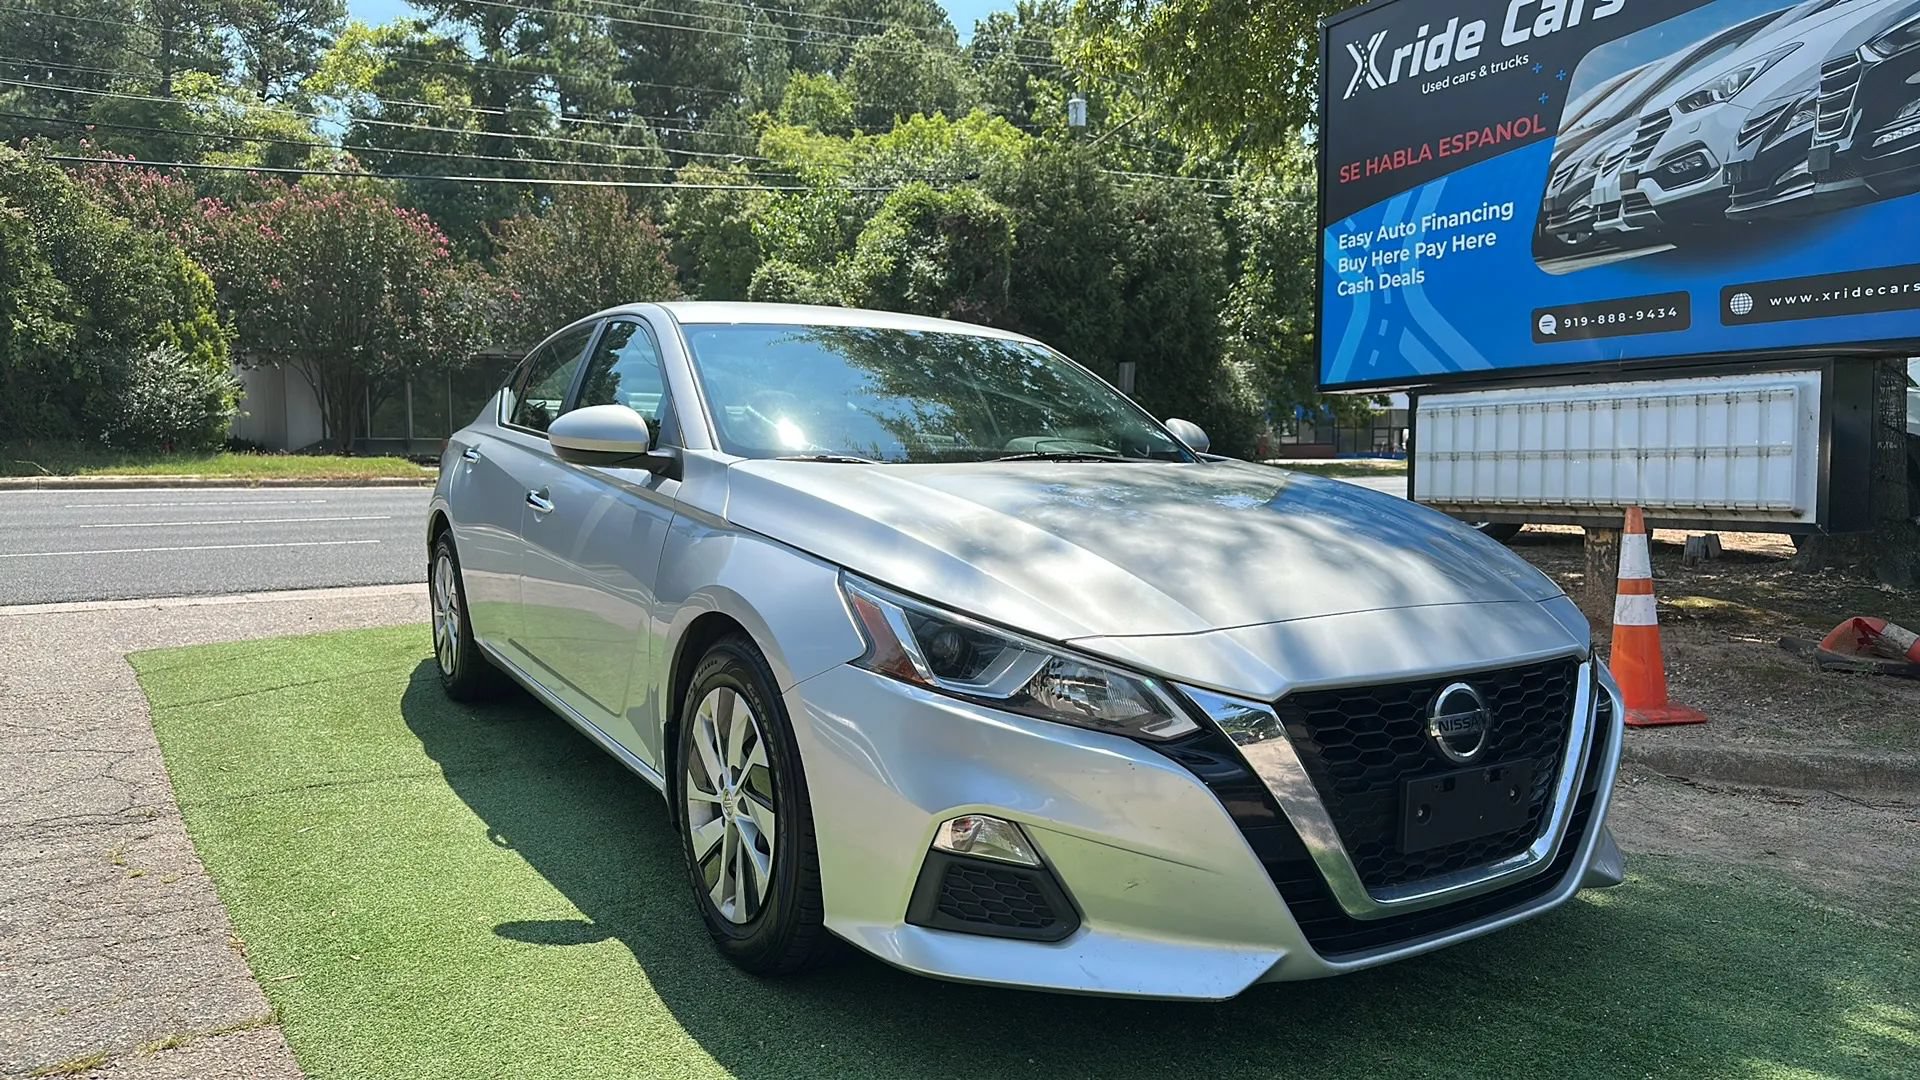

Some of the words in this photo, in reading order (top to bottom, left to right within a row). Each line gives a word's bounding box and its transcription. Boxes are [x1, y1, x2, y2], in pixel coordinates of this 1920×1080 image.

[1421, 77, 1449, 95] Used
[1452, 70, 1476, 85] cars
[1479, 66, 1488, 77] &
[1490, 53, 1529, 74] trucks
[1339, 162, 1361, 184] SE
[1366, 143, 1432, 177] HABLA
[1439, 114, 1546, 158] ESPANOL
[1339, 230, 1373, 250] Easy
[1376, 222, 1416, 242] Auto
[1421, 201, 1514, 232] Financing
[1338, 256, 1367, 274] Buy
[1371, 248, 1409, 267] Here
[1415, 241, 1447, 259] Pay
[1452, 232, 1497, 252] Here
[1337, 276, 1374, 296] Cash
[1379, 268, 1425, 290] Deals
[1564, 306, 1678, 328] 919-888-9434
[1438, 712, 1488, 732] NISSAN
